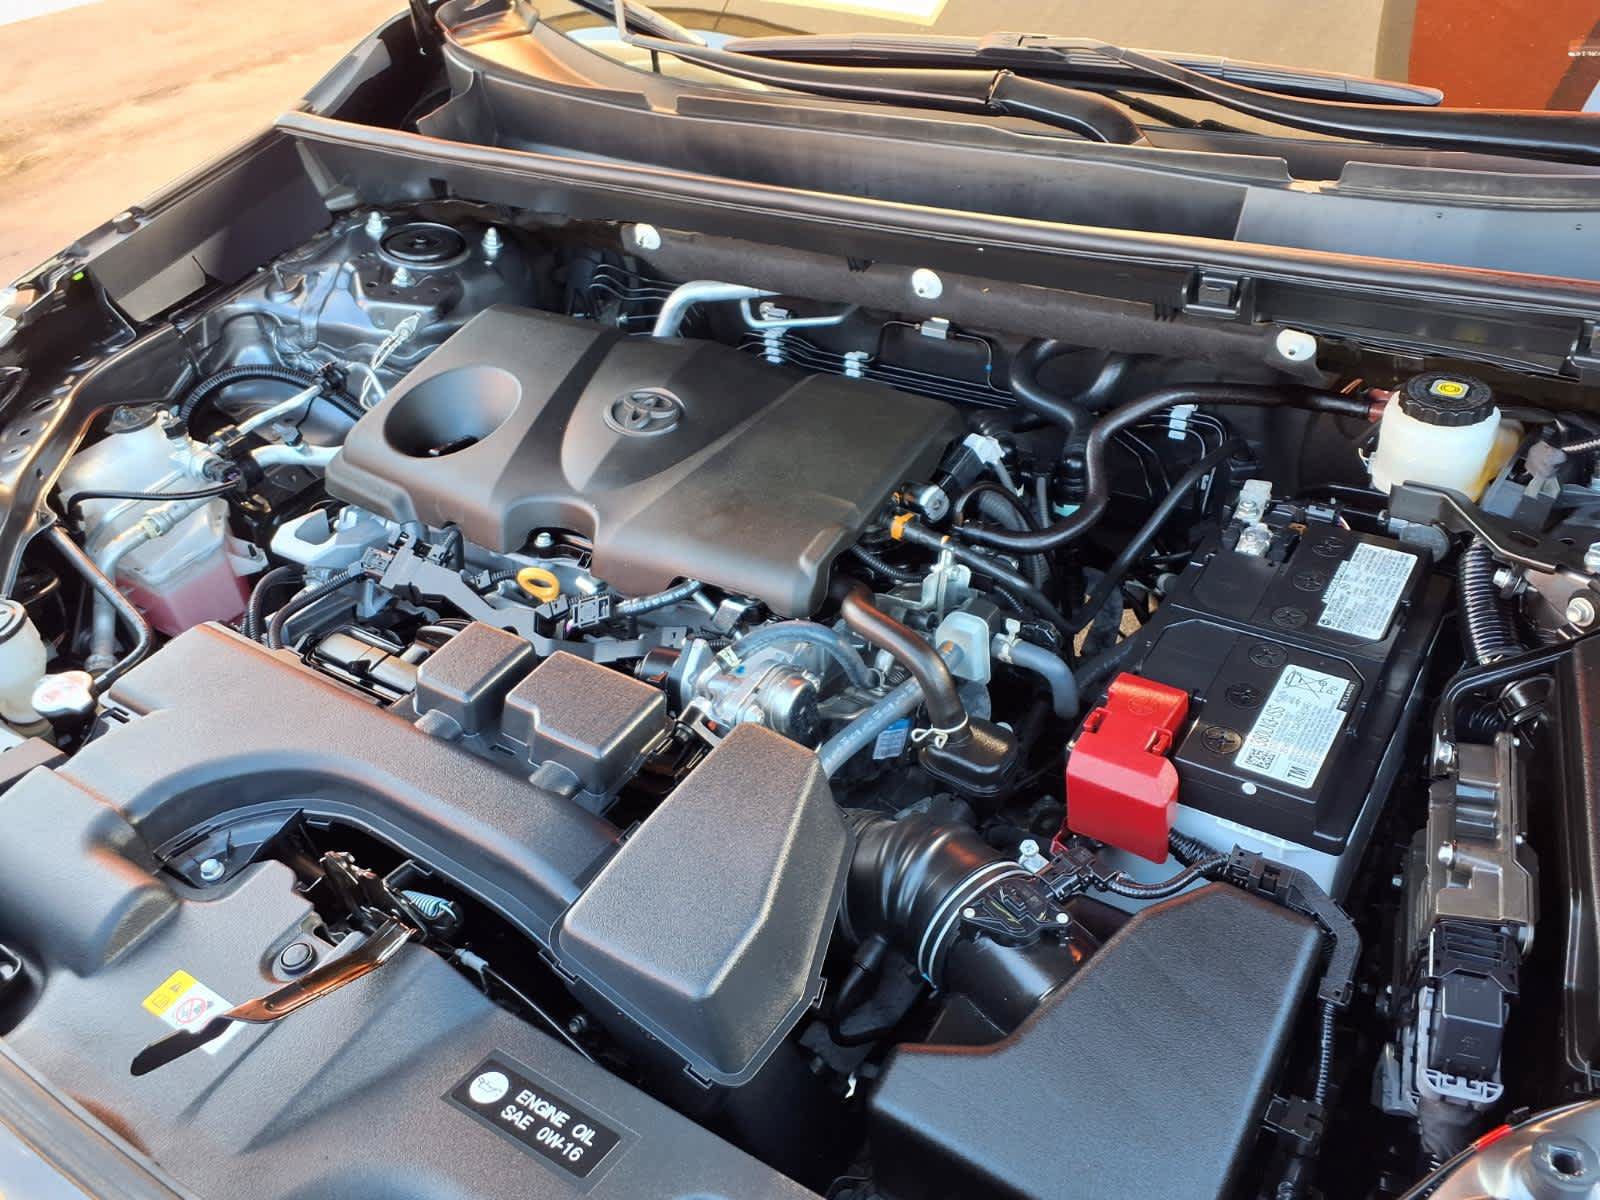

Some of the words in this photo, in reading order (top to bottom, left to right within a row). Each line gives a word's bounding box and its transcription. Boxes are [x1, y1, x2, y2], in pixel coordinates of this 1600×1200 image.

[500, 1104, 535, 1131] SAE
[535, 1126, 584, 1161] 0W-16
[515, 1089, 571, 1128] ENGINE
[571, 1123, 597, 1147] OIL
